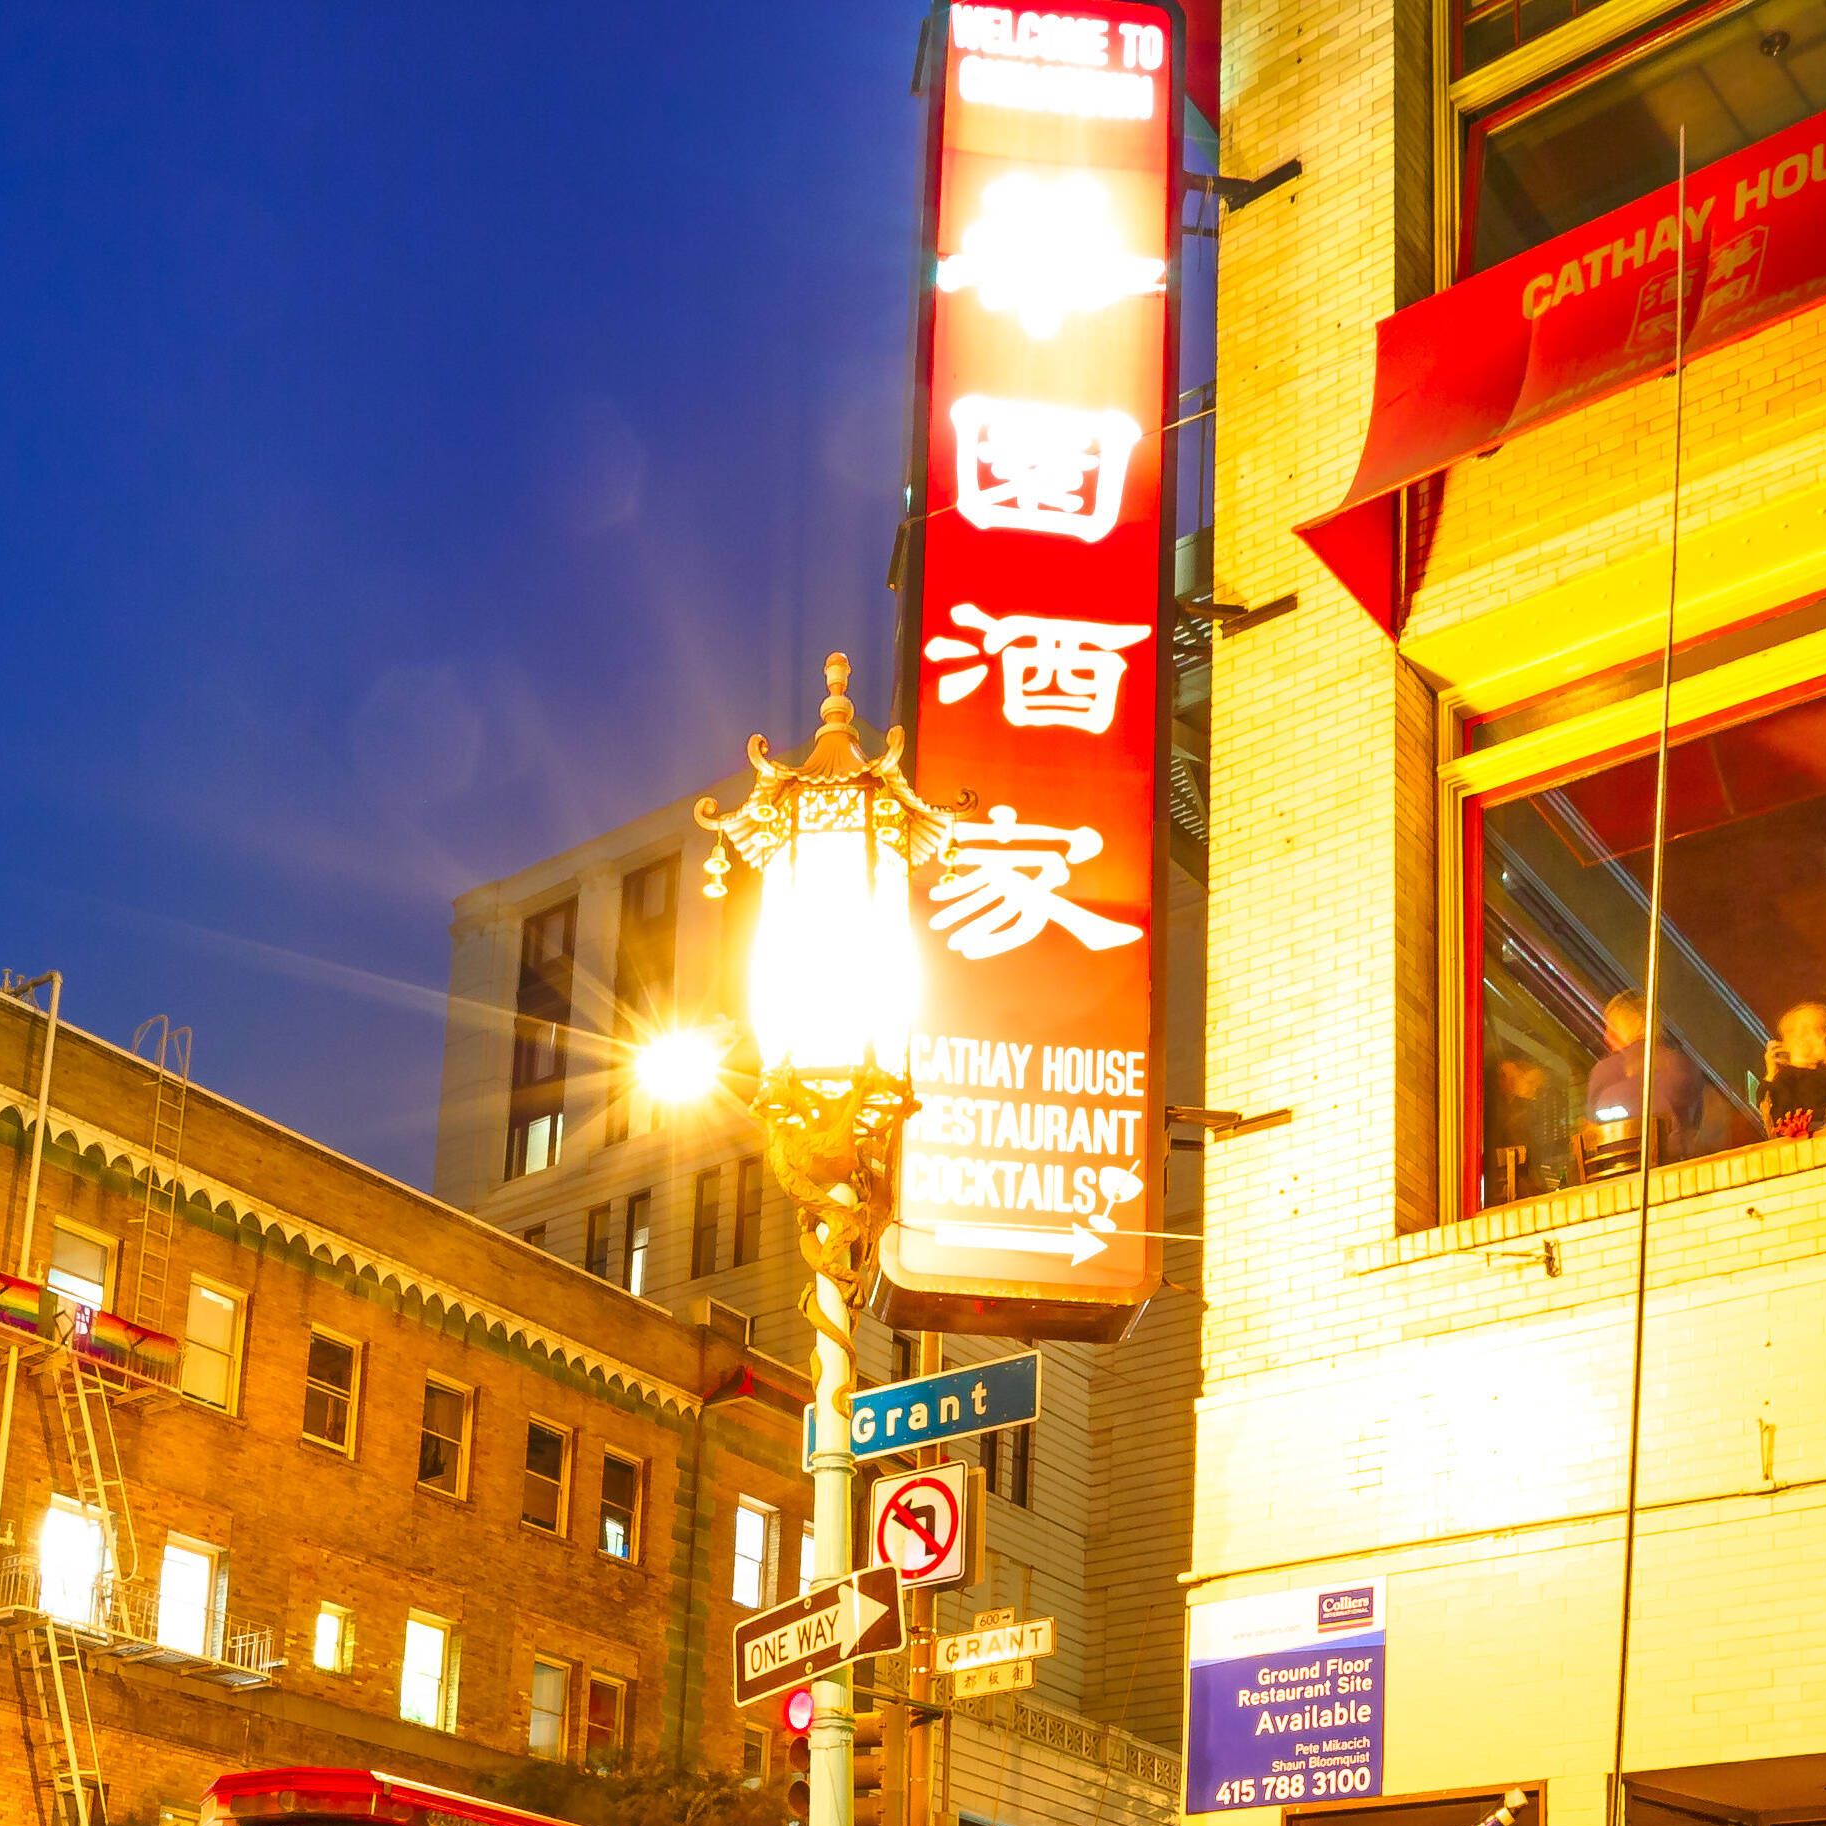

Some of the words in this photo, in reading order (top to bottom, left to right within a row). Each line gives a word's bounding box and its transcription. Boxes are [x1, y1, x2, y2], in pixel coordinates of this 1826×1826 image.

[1118, 22, 1164, 71] TO
[1522, 196, 1715, 320] CATHAY
[909, 1033, 1033, 1090] CATHAY
[1043, 1046, 1145, 1097] HOUSE
[907, 1092, 1142, 1156] RESTAURANT
[905, 1154, 1097, 1215] COCKTAILS
[851, 1379, 989, 1445] Grant
[979, 1613, 1000, 1627] 600
[1322, 1596, 1370, 1613] Colliers
[750, 1631, 789, 1673] ONE
[797, 1610, 840, 1654] WAY
[945, 1627, 1043, 1663] GRANT
[1257, 1661, 1320, 1686] Ground
[1326, 1656, 1373, 1678] Floor
[1238, 1681, 1331, 1708] Restaurant
[1337, 1675, 1373, 1693] Site
[1255, 1699, 1372, 1736] Available
[1271, 1760, 1306, 1773] Shaun
[1308, 1752, 1370, 1769] Bloomquist
[1295, 1743, 1320, 1756] Pete
[1215, 1777, 1256, 1806] 415
[1261, 1774, 1306, 1802] 788
[1312, 1766, 1372, 1796] 3100
